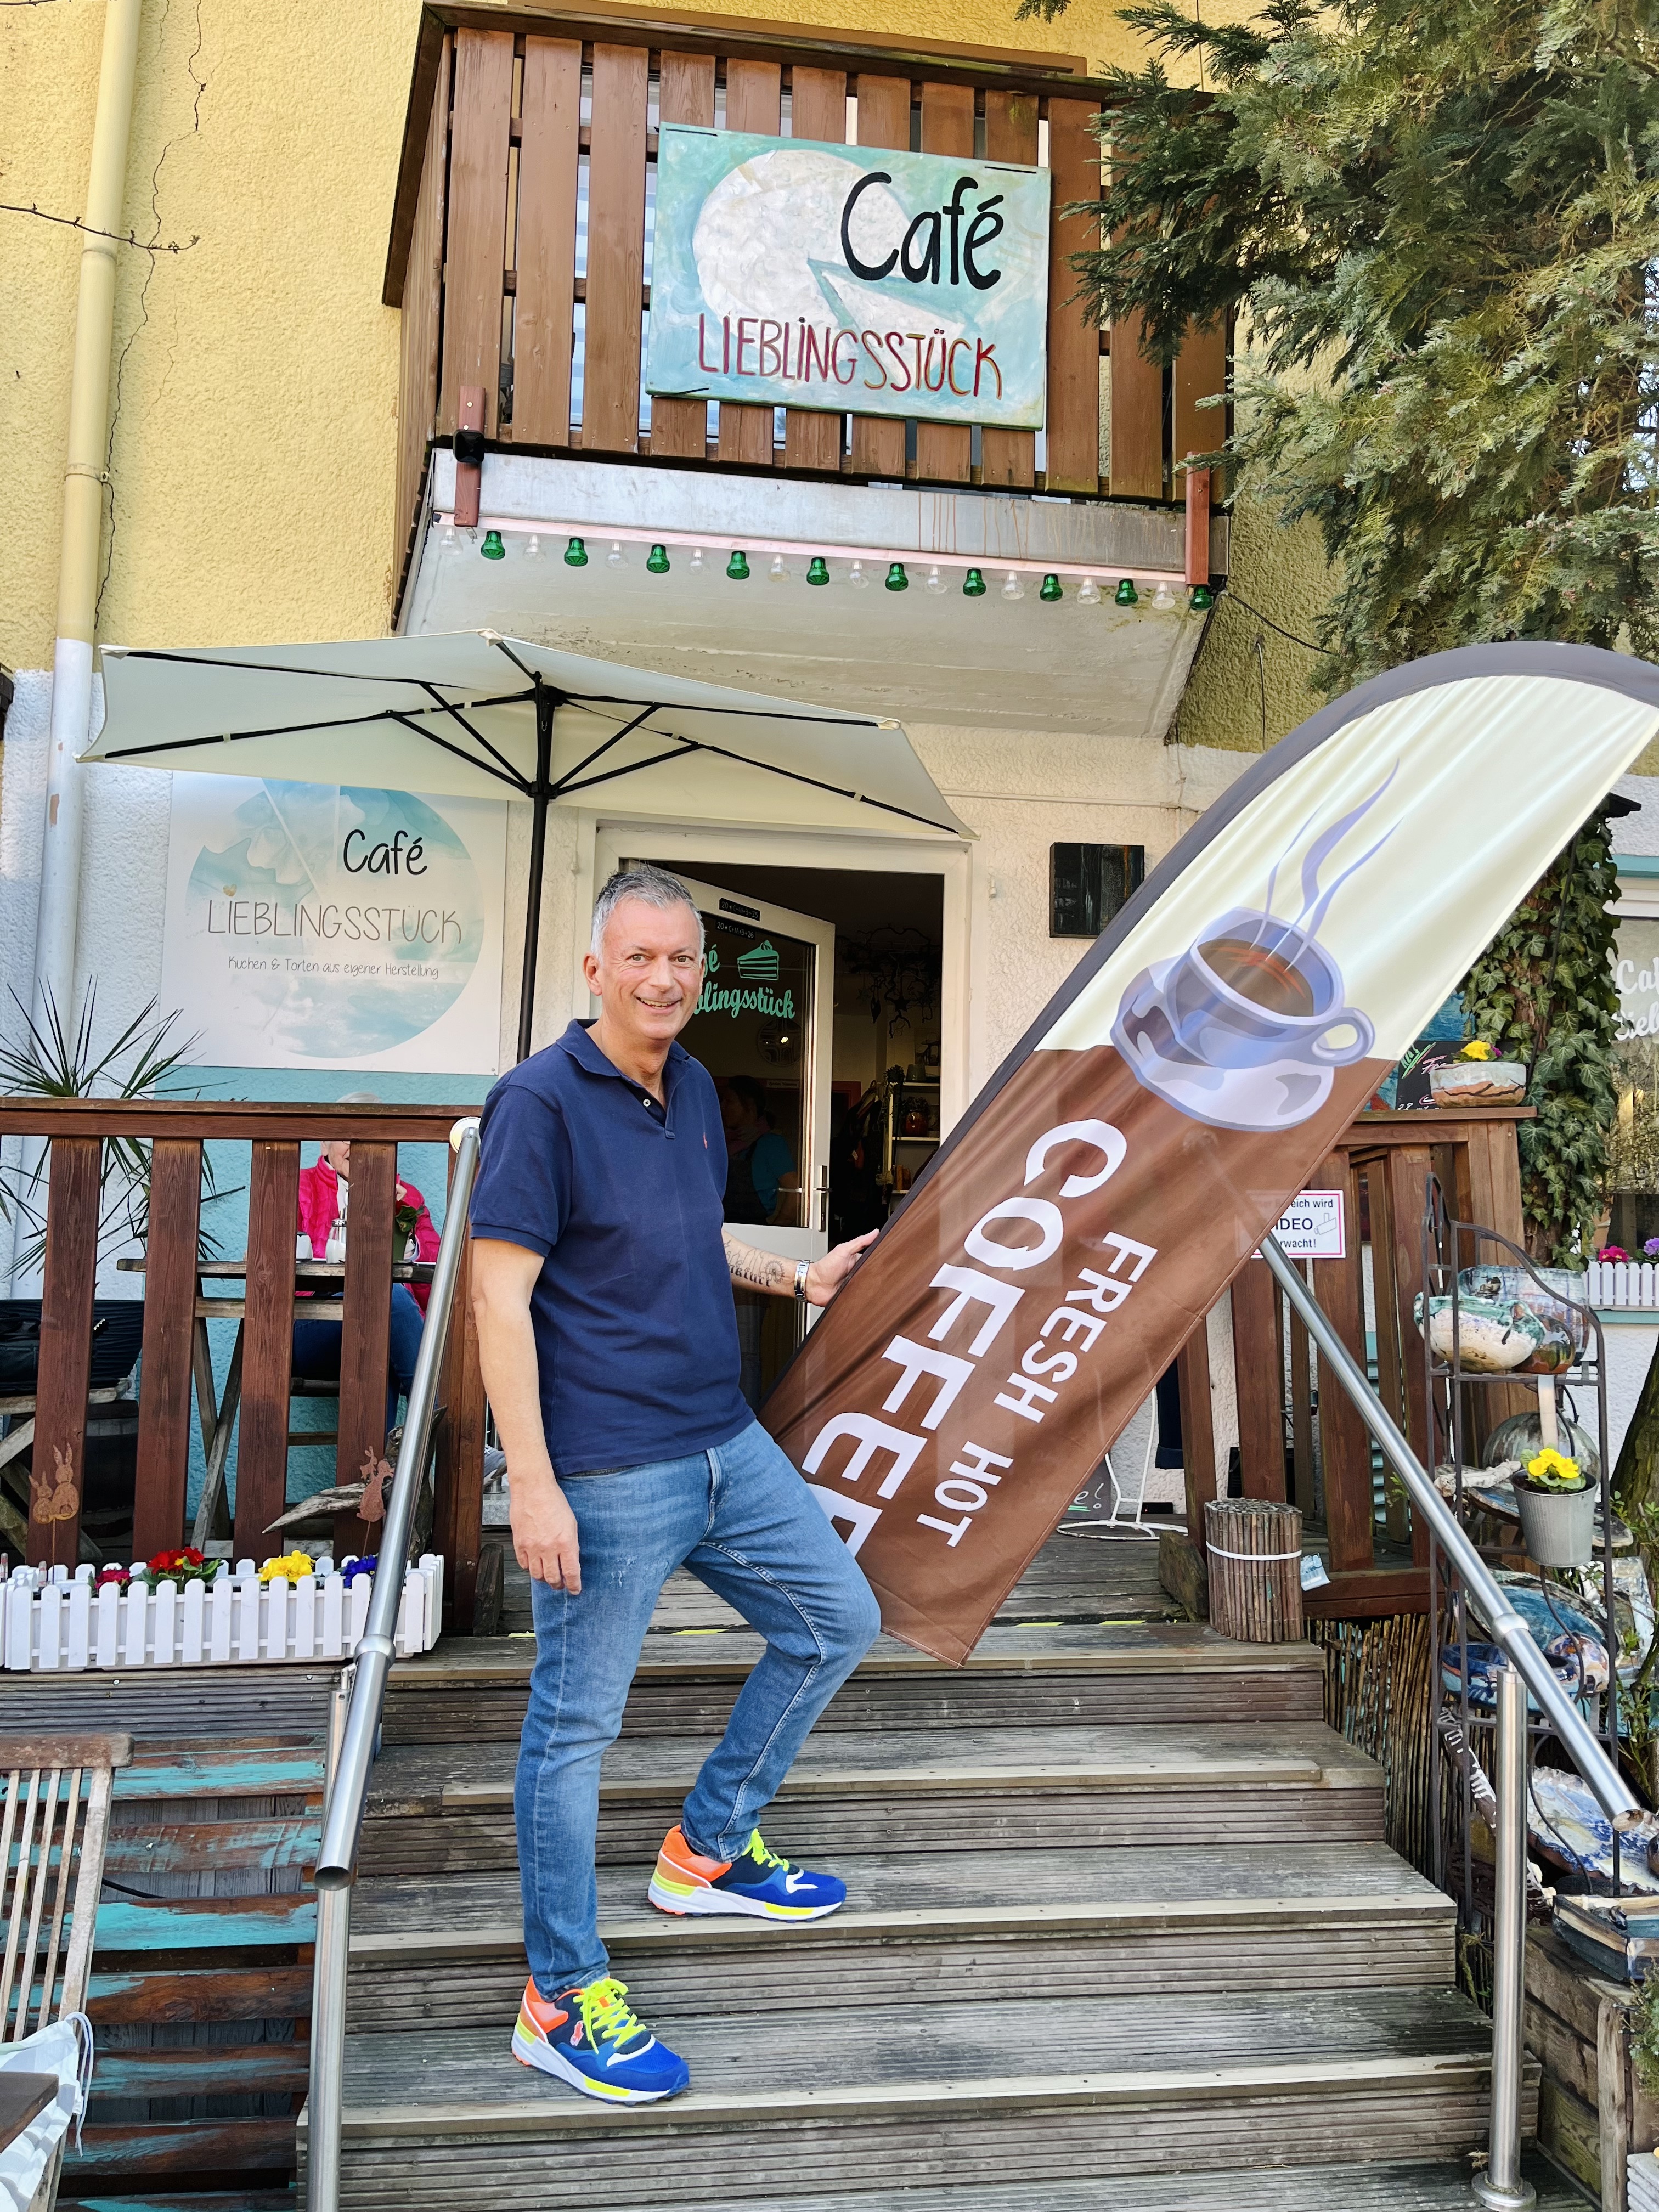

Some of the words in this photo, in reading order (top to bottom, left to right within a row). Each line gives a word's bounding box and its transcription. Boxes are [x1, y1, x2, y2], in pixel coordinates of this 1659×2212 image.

[840, 172, 1004, 290] Café
[343, 829, 428, 876] Café
[208, 899, 462, 944] LIEBLINGSSTÜCK
[228, 956, 267, 970] Kuchen
[271, 958, 280, 970] &
[284, 958, 319, 973] Torten
[322, 962, 340, 973] aus
[343, 964, 382, 977] eigener
[385, 962, 439, 980] Herstellung
[1276, 1218, 1313, 1231] IDEO
[1291, 1198, 1310, 1208] eich
[1312, 1198, 1334, 1208] wird
[1279, 1238, 1317, 1248] rwacht!
[993, 1231, 1158, 1423] FRESH
[916, 1441, 1014, 1548] HOT
